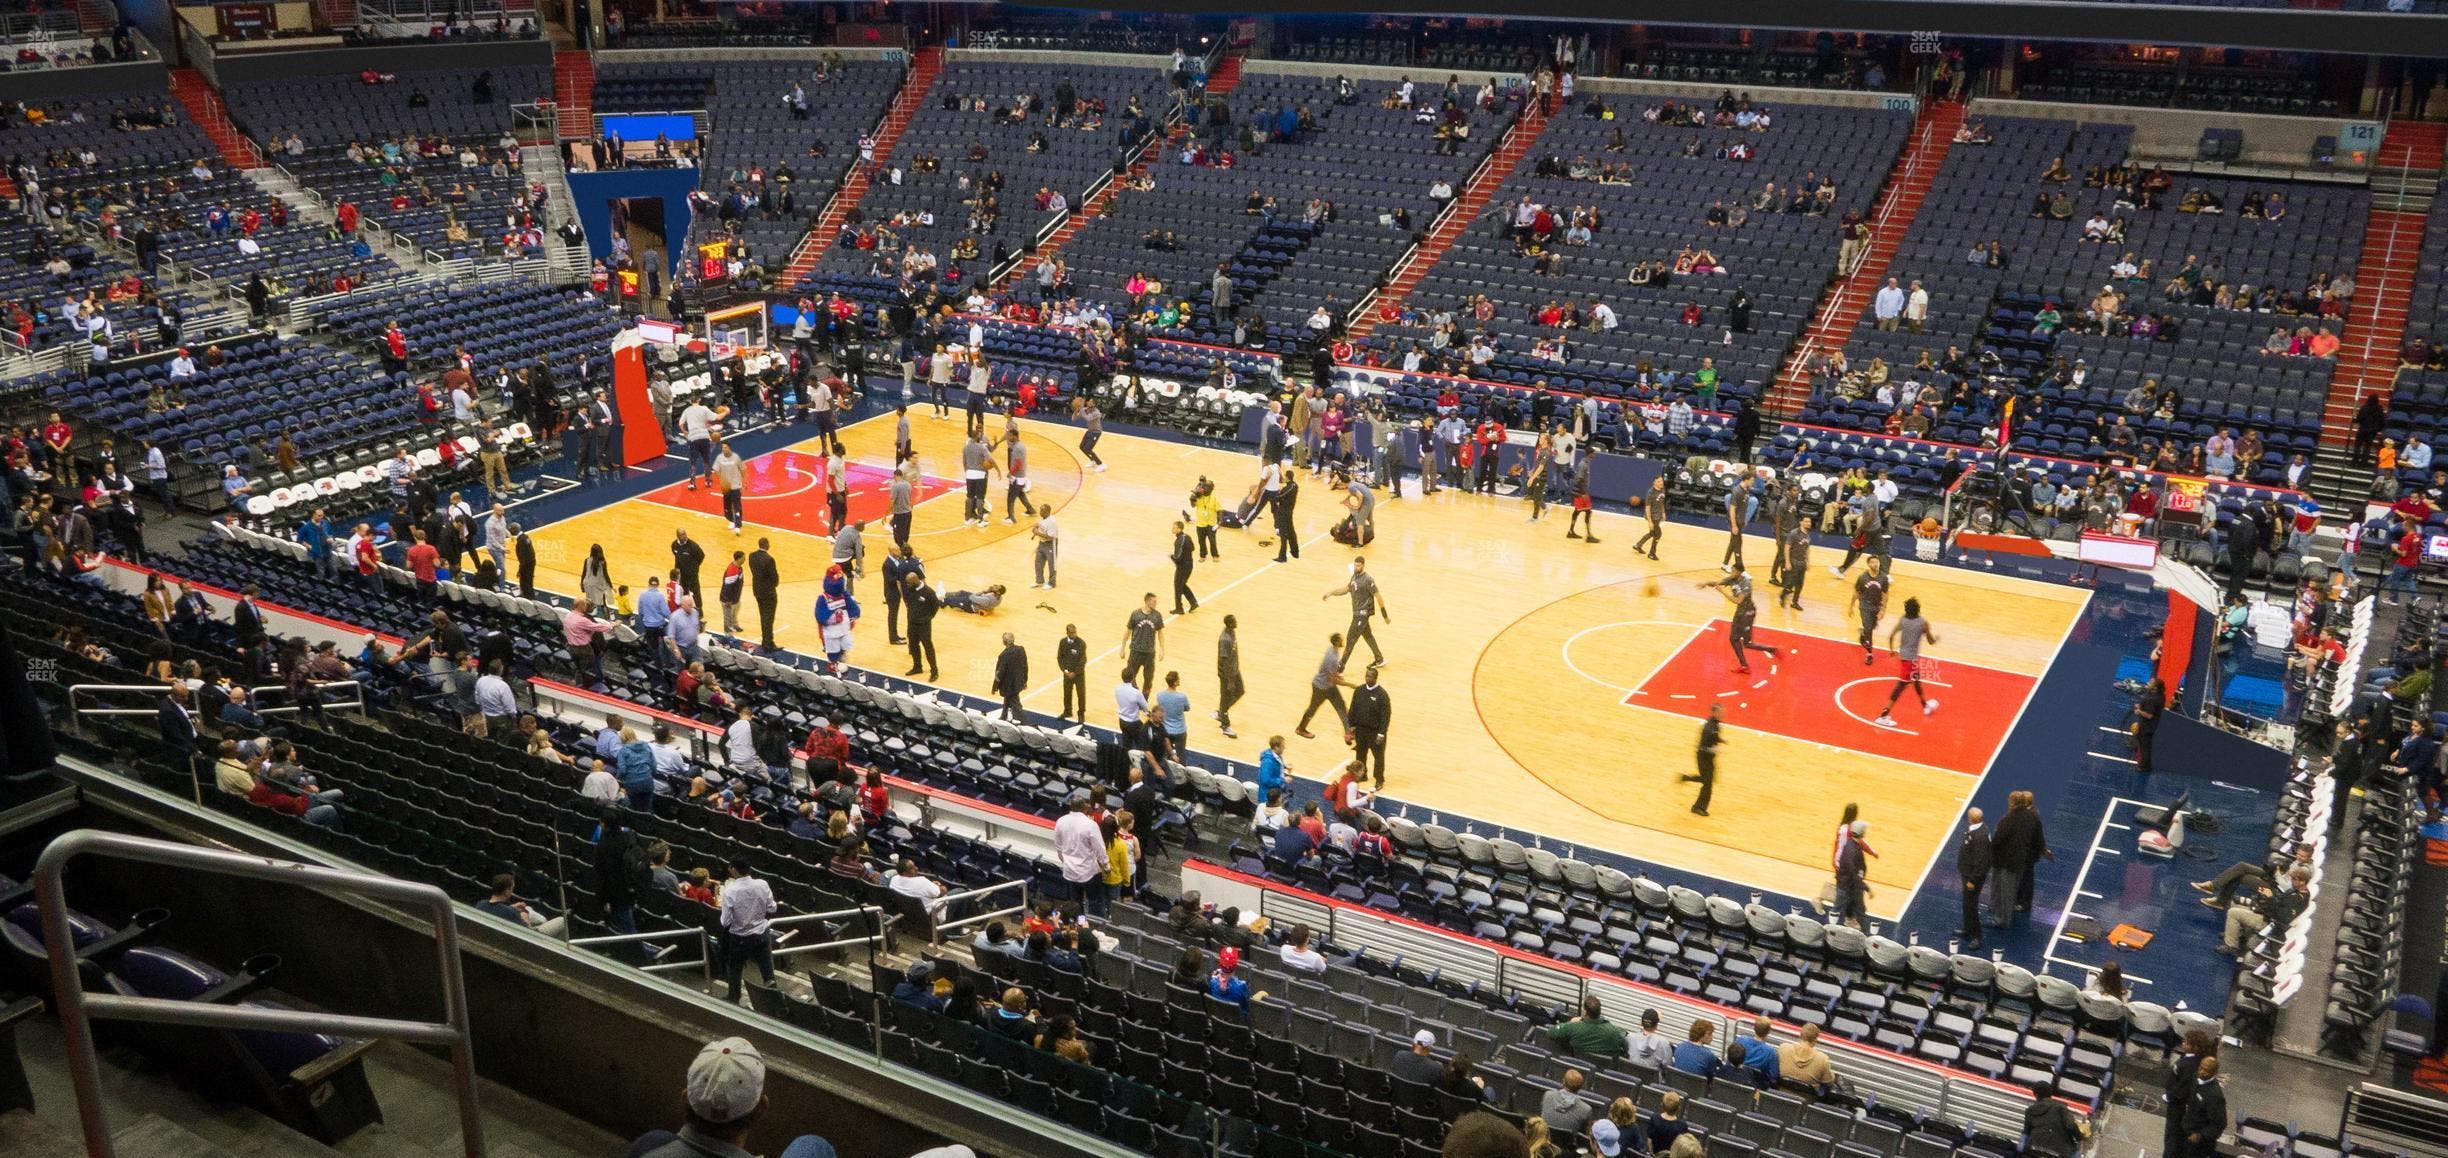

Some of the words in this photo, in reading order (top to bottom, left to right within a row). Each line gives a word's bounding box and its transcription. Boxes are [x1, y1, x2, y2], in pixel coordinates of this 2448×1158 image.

[886, 52, 903, 60] 103
[1886, 98, 1910, 111] 100
[2350, 125, 2375, 139] 121
